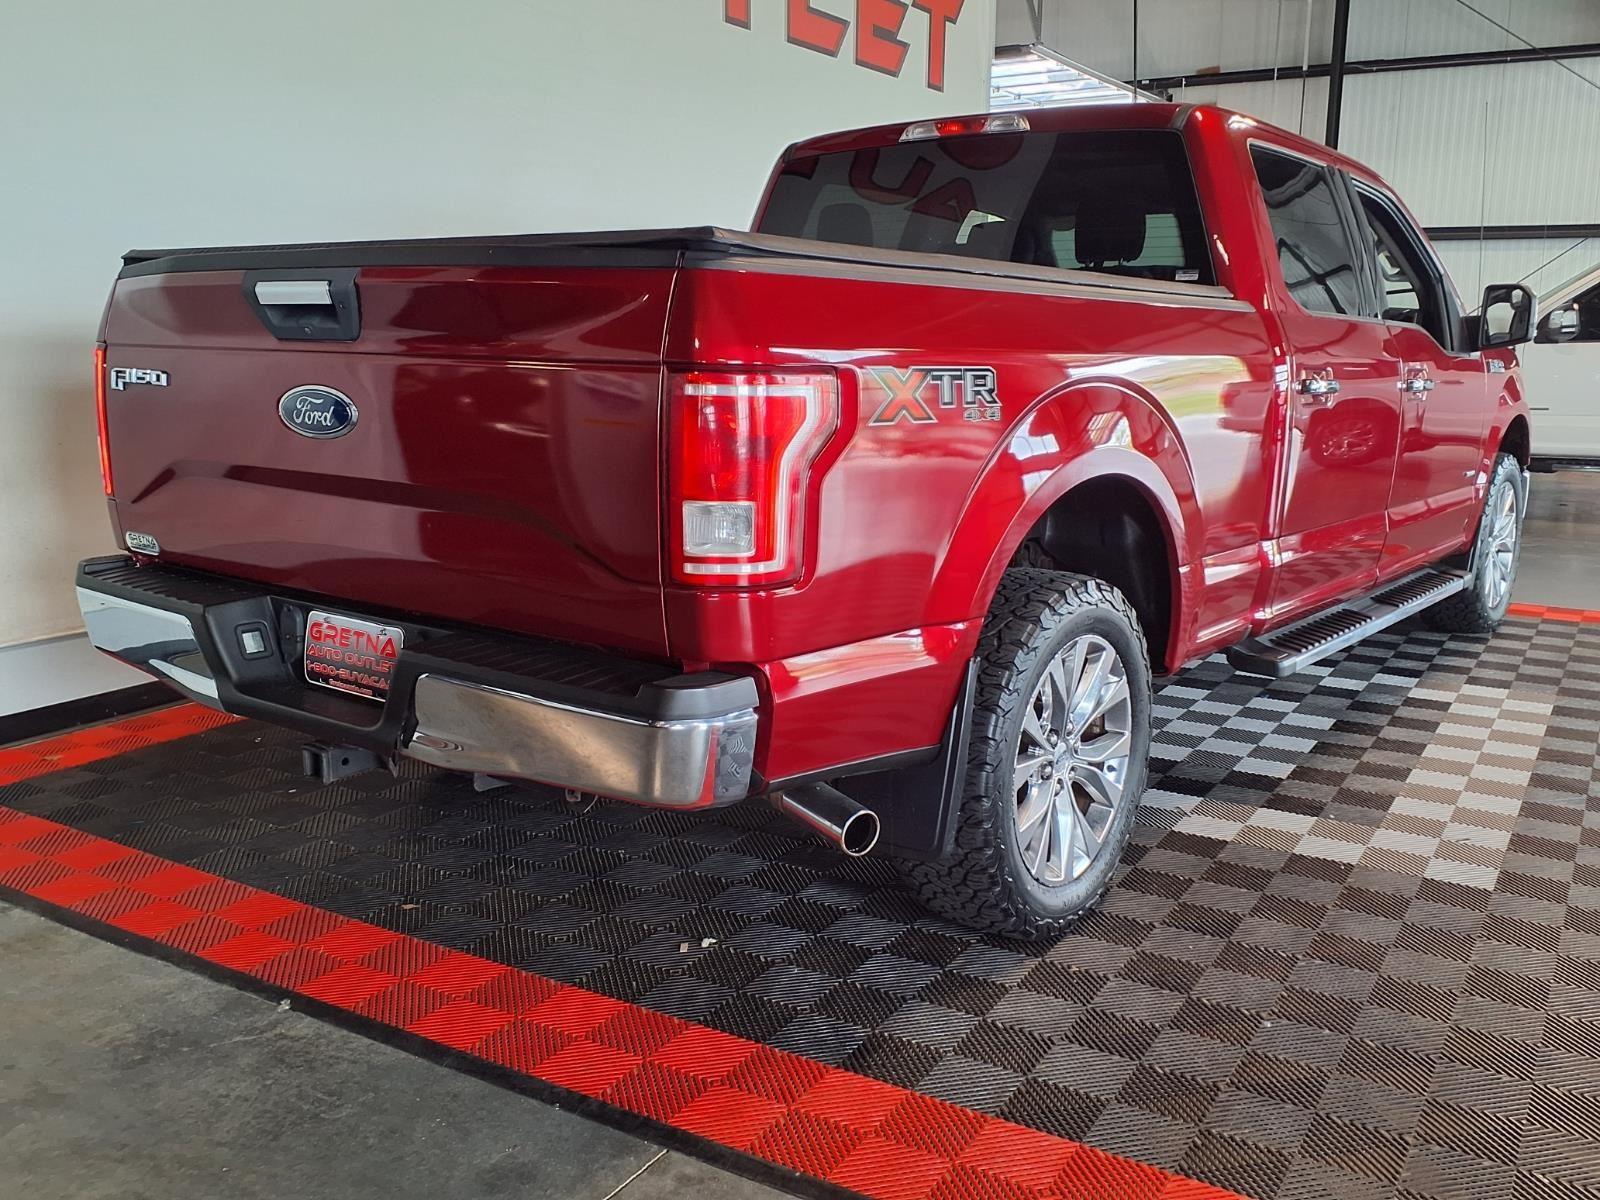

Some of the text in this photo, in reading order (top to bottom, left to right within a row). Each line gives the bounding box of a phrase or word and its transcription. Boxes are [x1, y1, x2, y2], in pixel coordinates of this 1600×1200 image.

[864, 365, 1002, 426] XTR
[293, 396, 334, 426] Ford
[308, 643, 342, 663] AUTO
[309, 621, 398, 659] GRETNA
[307, 660, 390, 690] 1-800-BUYACA
